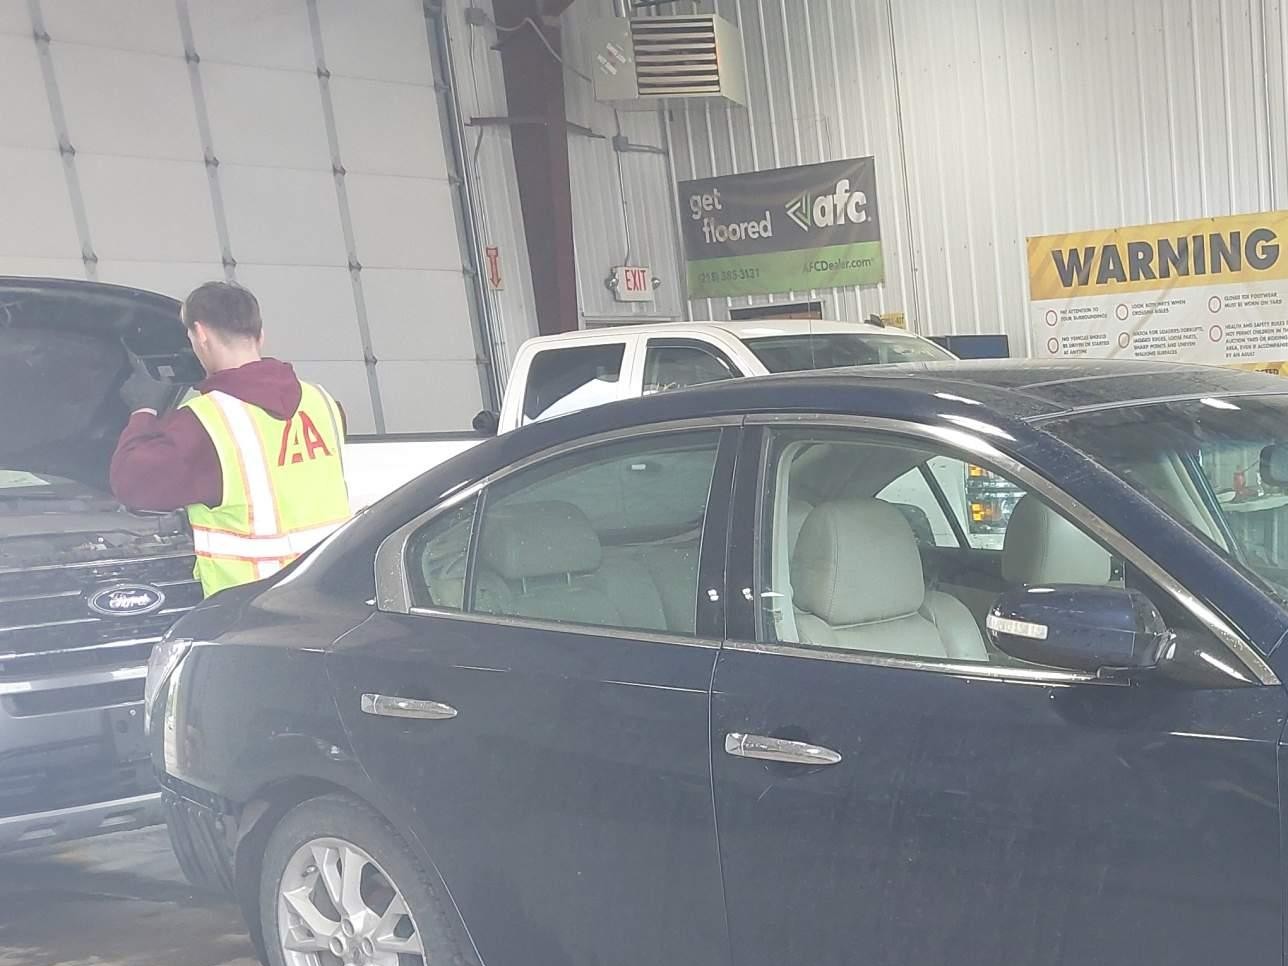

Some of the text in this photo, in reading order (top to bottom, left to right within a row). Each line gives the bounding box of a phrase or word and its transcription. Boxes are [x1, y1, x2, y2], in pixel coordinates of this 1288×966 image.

[689, 188, 722, 220] get
[702, 211, 773, 244] floored
[1051, 228, 1280, 288] WARNING
[624, 269, 647, 291] EXIT
